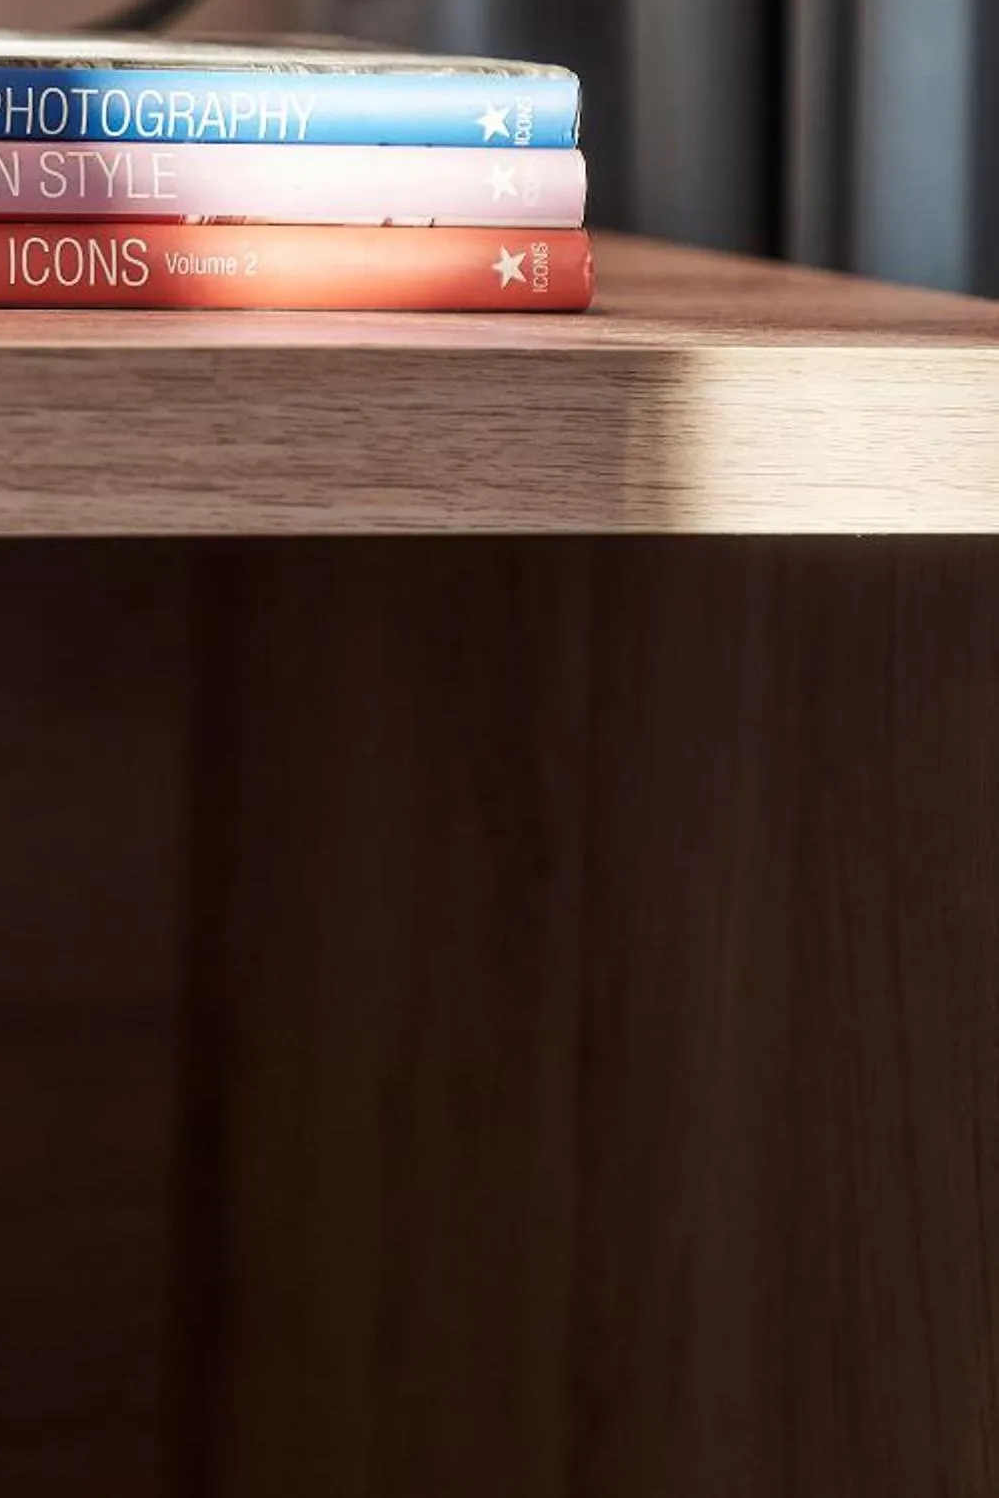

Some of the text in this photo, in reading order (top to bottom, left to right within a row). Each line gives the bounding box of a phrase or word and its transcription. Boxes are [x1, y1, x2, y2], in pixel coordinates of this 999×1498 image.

[514, 96, 533, 146] ICONS
[39, 151, 178, 200] STYLE
[8, 236, 150, 287] ICONS
[165, 252, 238, 277] Volume
[245, 251, 258, 277] 2
[531, 242, 549, 293] ICONS
